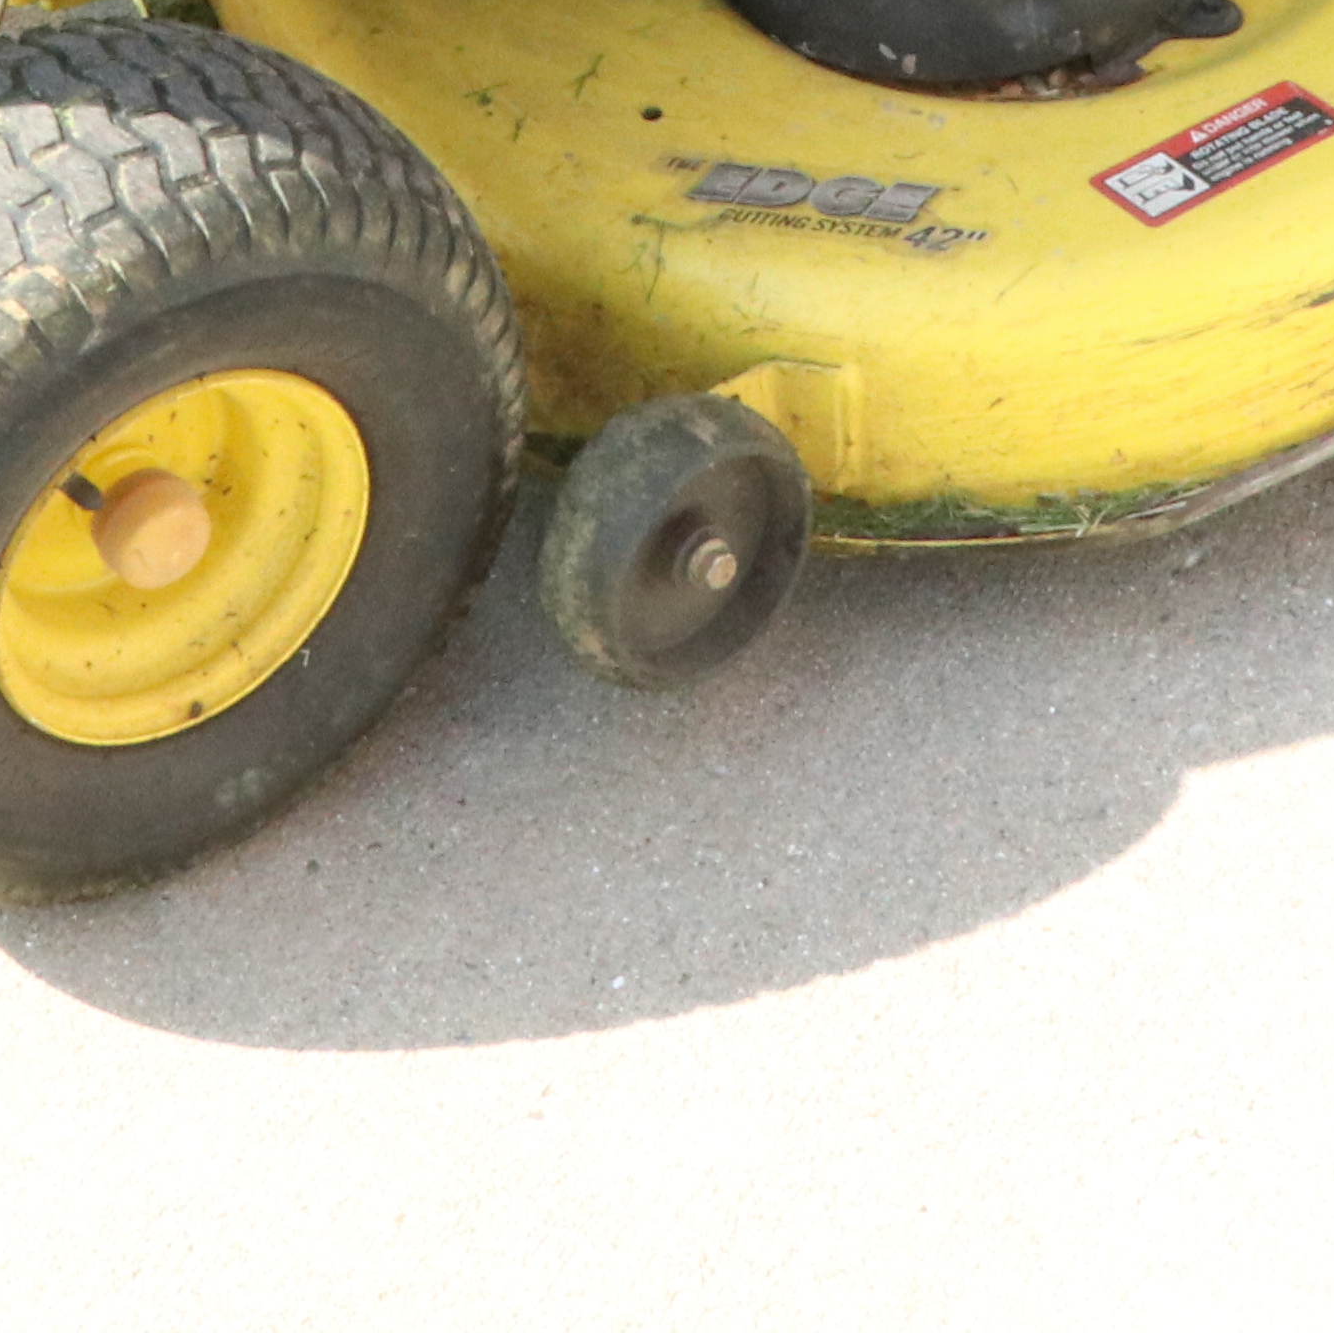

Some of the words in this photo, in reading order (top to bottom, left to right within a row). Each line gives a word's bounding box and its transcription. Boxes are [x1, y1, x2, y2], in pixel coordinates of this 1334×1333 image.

[1201, 97, 1268, 134] DANGER
[684, 161, 943, 224] EDGE
[722, 207, 811, 230] CUTTING
[811, 217, 902, 239] SYSTEM
[901, 225, 988, 252] 42"
